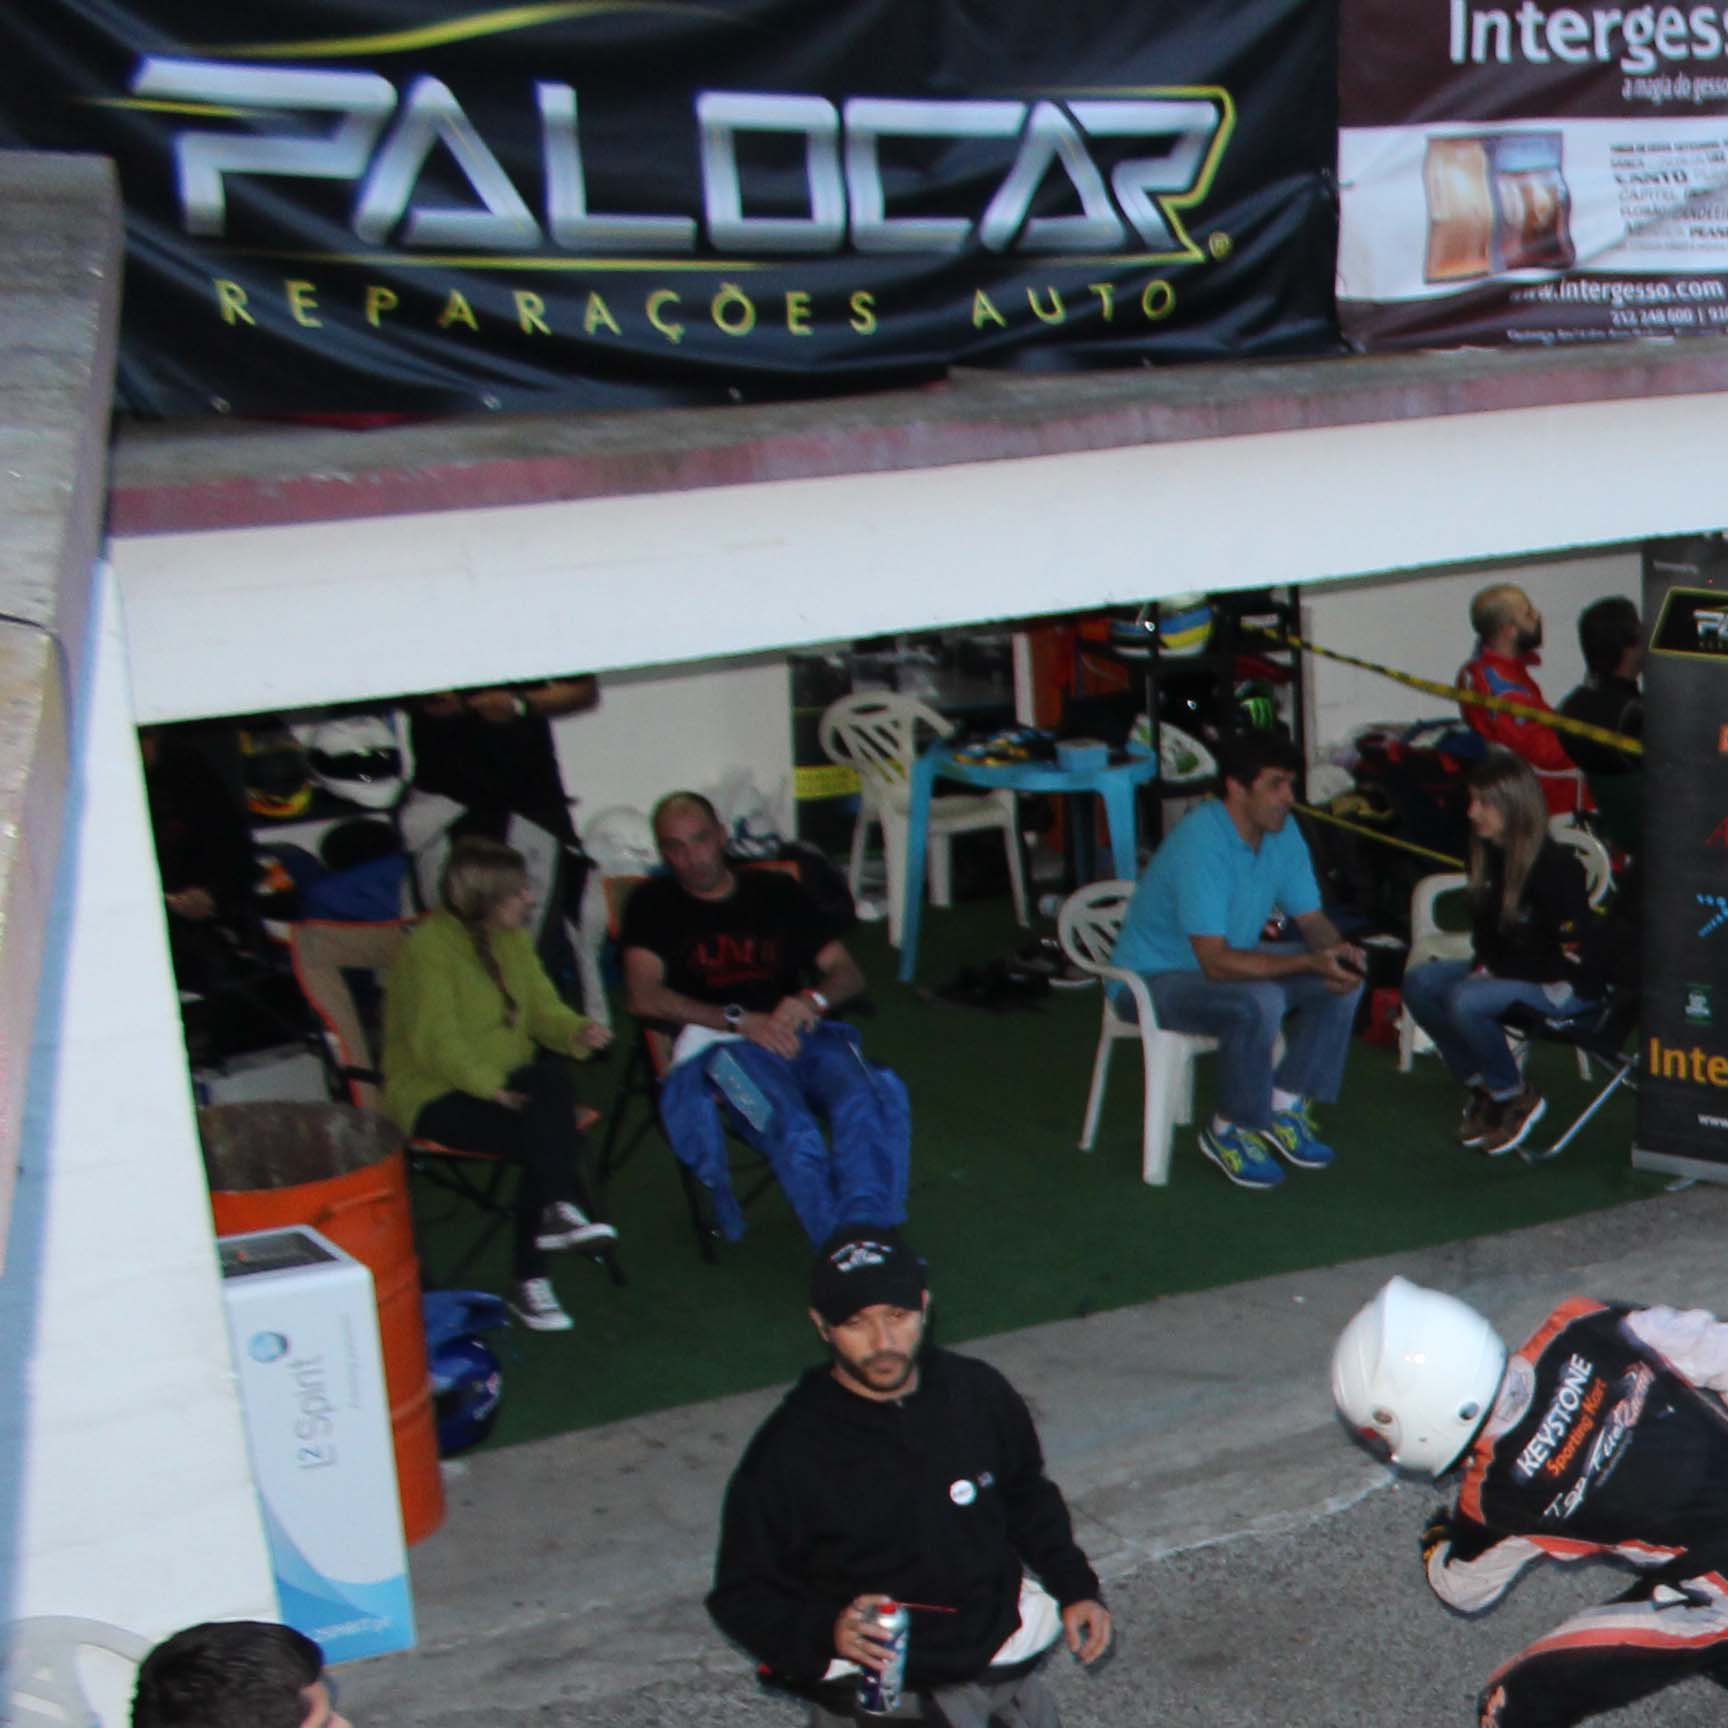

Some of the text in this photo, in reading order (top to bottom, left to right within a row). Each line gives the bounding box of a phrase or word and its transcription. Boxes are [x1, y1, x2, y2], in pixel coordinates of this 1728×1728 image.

[128, 55, 1222, 252] PALOCAR
[218, 278, 1178, 342] REPARAÇÕES AUTO
[1516, 1353, 1593, 1478] KEYSTONE
[1545, 1414, 1595, 1478] Sporting
